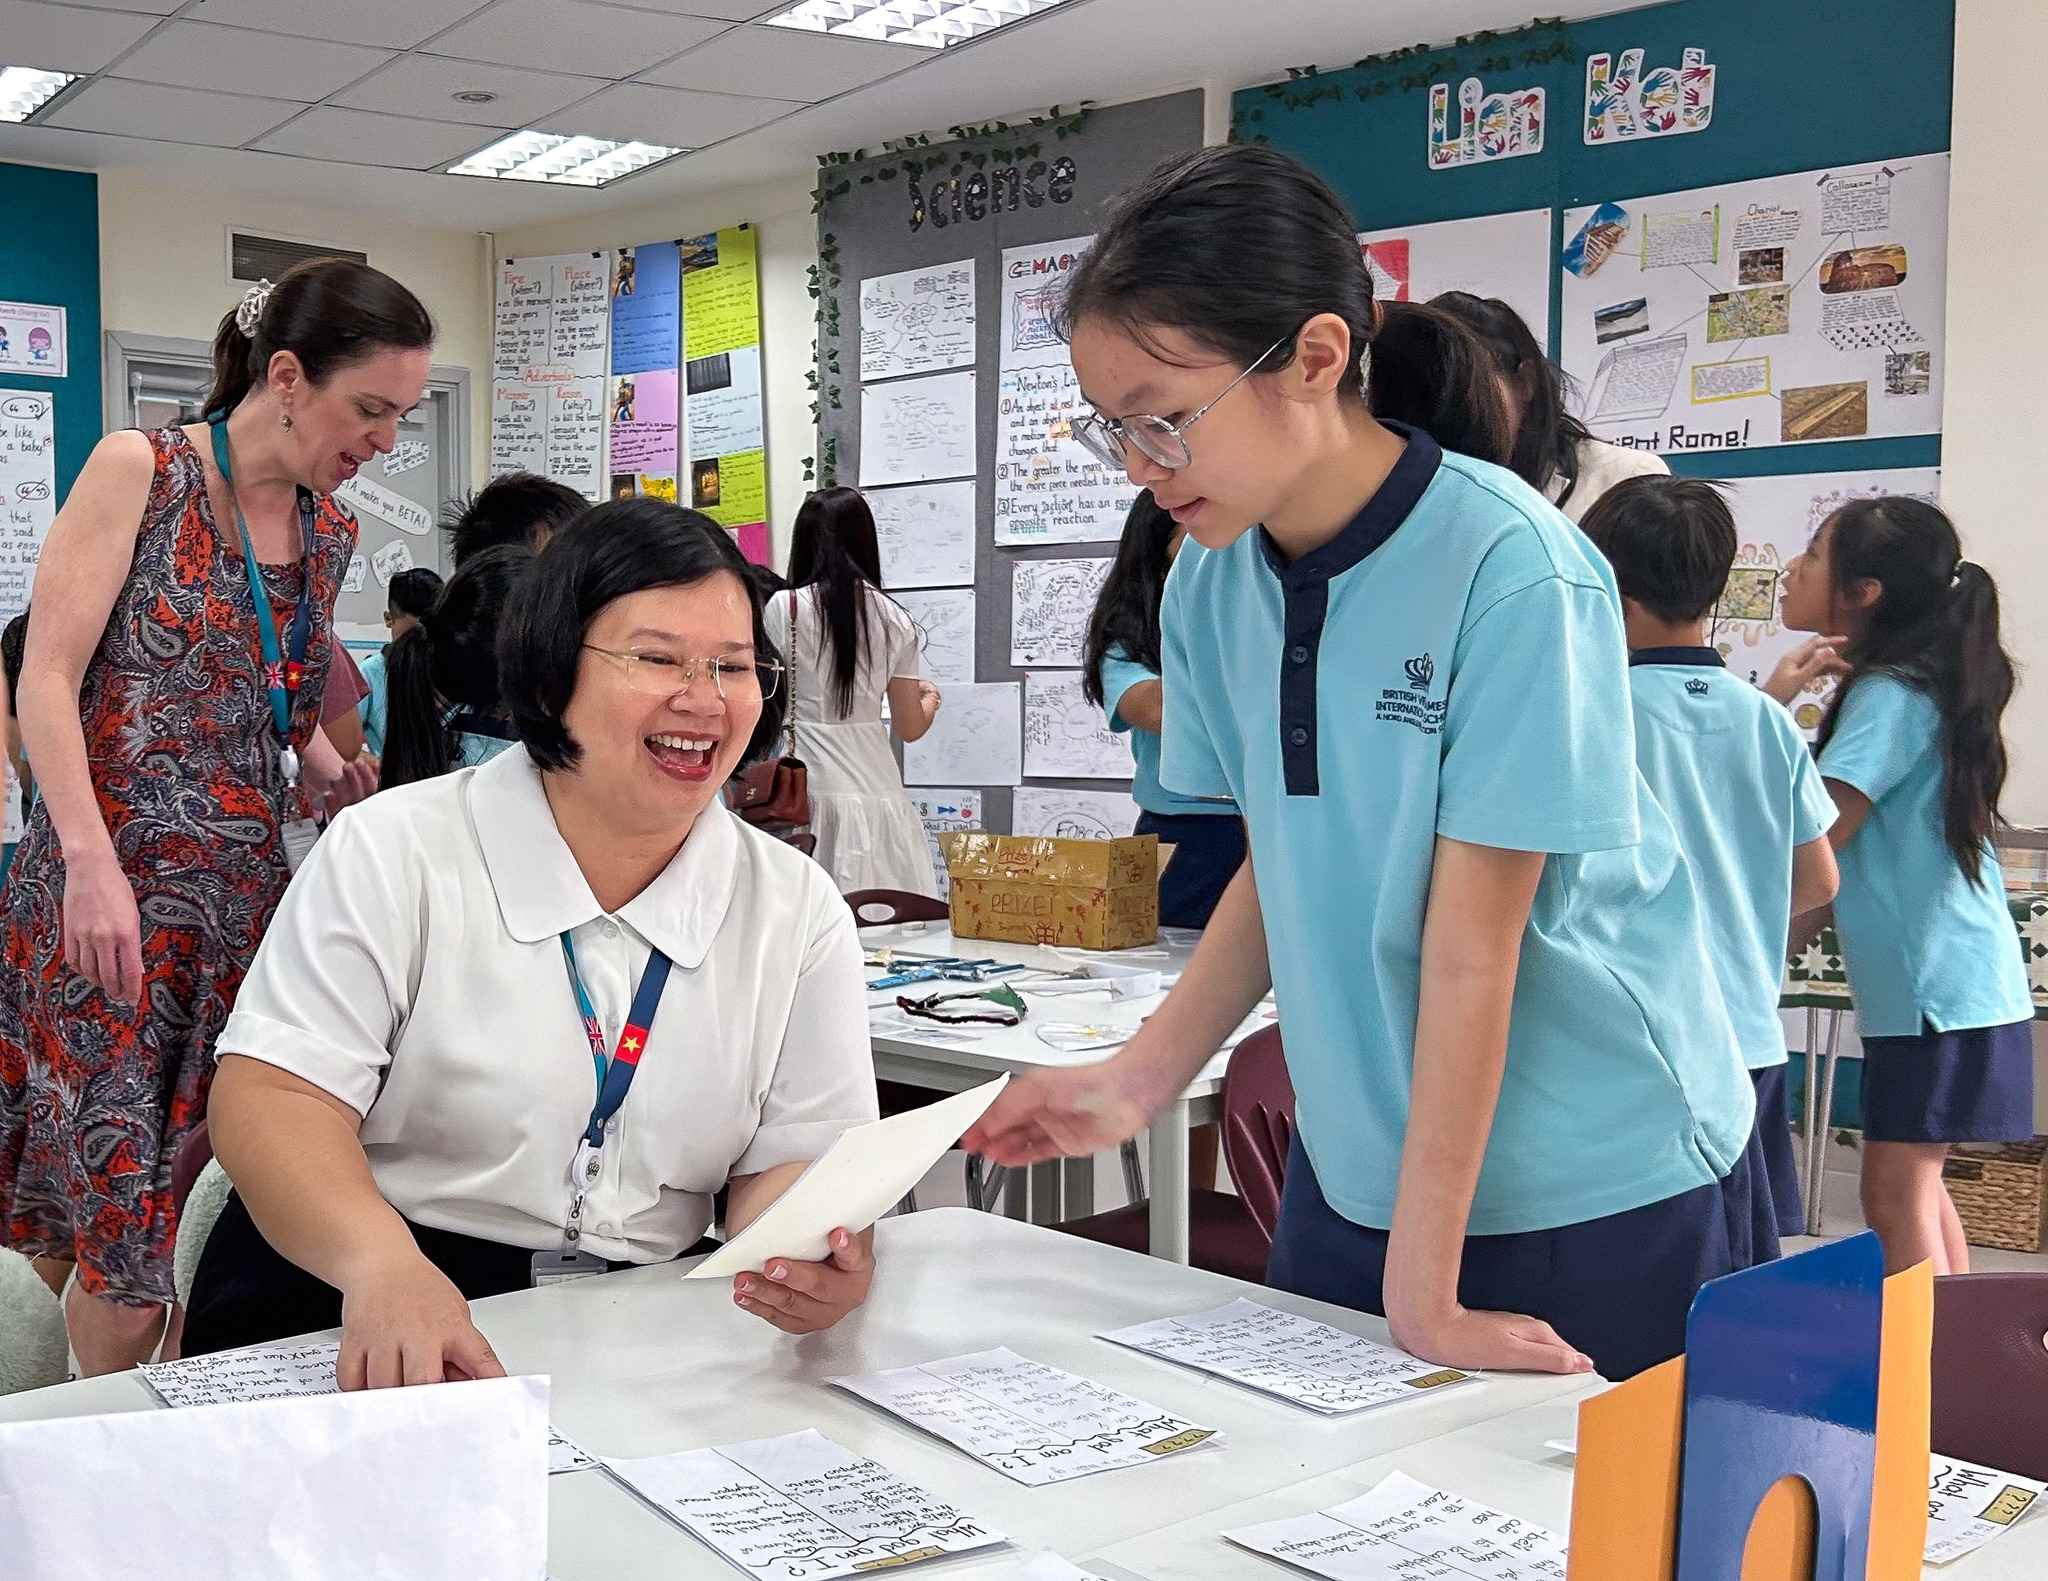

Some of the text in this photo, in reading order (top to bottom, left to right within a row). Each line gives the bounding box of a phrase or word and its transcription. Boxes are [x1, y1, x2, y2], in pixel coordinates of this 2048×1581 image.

[908, 156, 1077, 232] Science
[564, 268, 592, 280] Place
[1017, 374, 1058, 392] Newton's
[562, 399, 592, 414] (why?)
[14, 424, 33, 439] like
[1669, 419, 1750, 449] Rome!
[21, 436, 43, 455] baby
[1010, 462, 1028, 477] The
[1065, 460, 1078, 473] the
[1009, 480, 1023, 492] the
[1026, 481, 1046, 491] more
[1069, 474, 1098, 488] needed
[1011, 498, 1038, 516] Every
[1078, 496, 1095, 510] has
[1100, 499, 1111, 509] an
[10, 513, 32, 523] that
[398, 503, 425, 529] BETA!
[1383, 689, 1417, 703] BRITISH
[923, 820, 941, 831] What
[944, 822, 949, 832] I
[1129, 1418, 1190, 1440] What
[1039, 1446, 1072, 1460] am
[1088, 1434, 1124, 1454] god
[1938, 1467, 1998, 1500] What
[1416, 1491, 1449, 1508] Zeus
[928, 1523, 987, 1543] What
[834, 1547, 875, 1560] am
[879, 1537, 920, 1557] god
